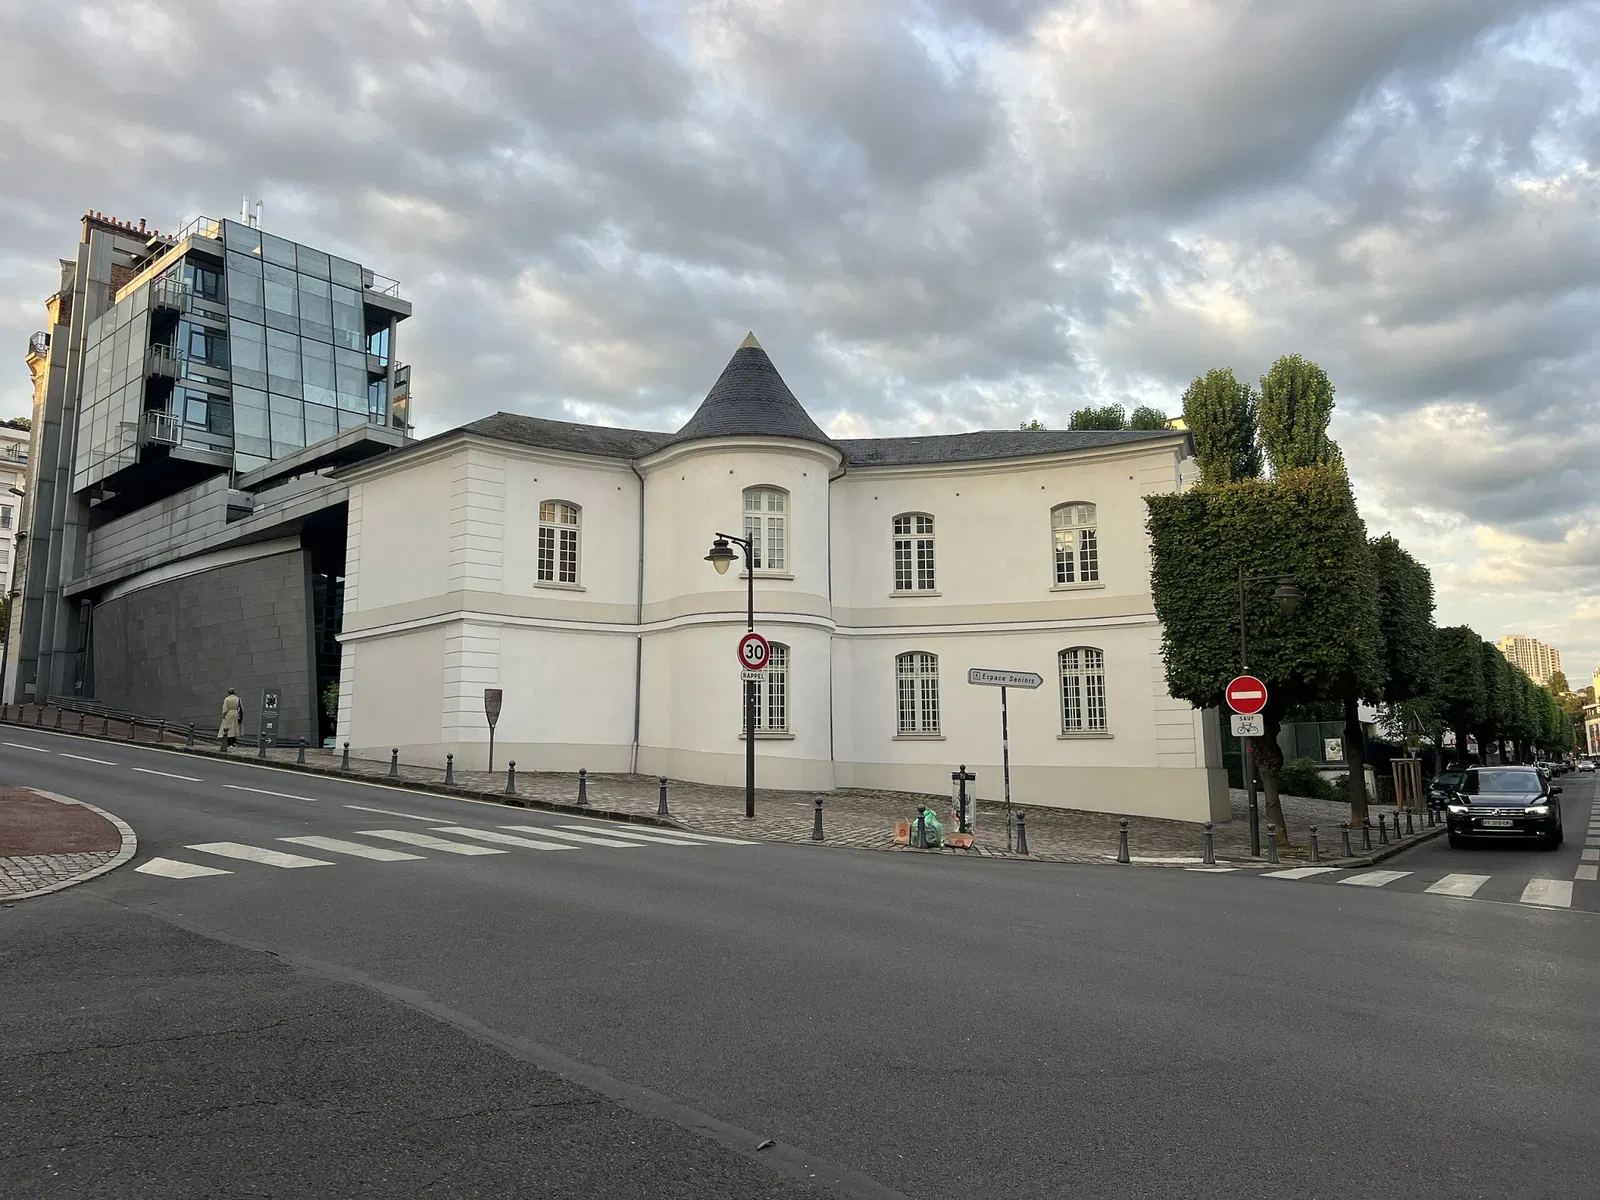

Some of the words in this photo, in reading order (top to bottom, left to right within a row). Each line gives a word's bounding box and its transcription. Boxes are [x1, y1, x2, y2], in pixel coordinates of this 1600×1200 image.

[745, 643, 764, 660] 30
[742, 672, 765, 680] RAPPEL
[982, 672, 1006, 682] Espace
[1008, 675, 1035, 684] Seniors
